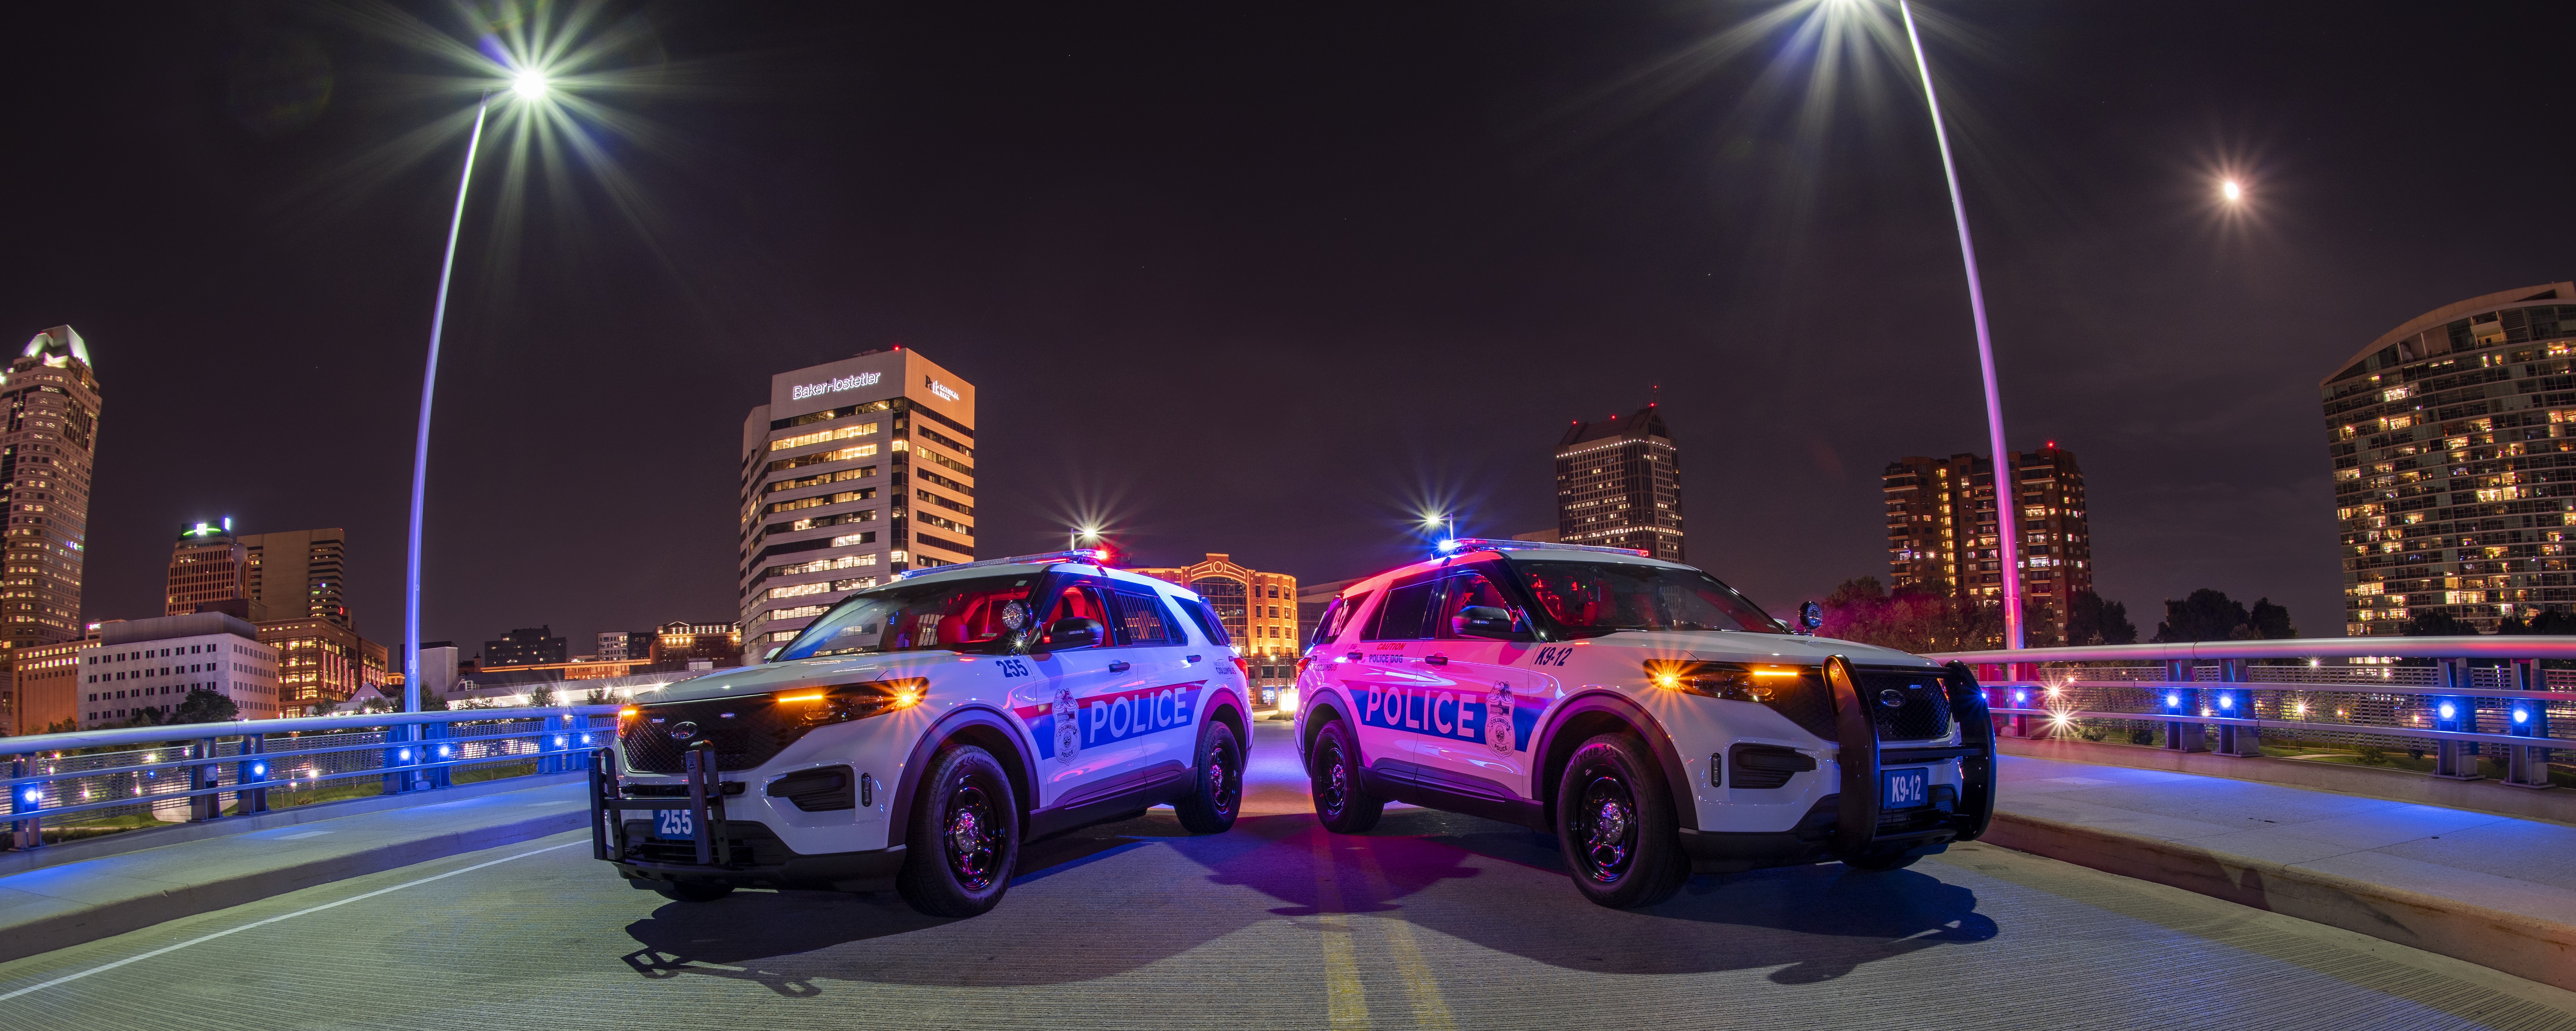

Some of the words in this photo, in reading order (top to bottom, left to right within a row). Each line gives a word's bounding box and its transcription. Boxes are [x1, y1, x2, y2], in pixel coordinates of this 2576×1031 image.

[793, 373, 880, 399] BakerHostetler
[1369, 654, 1389, 662] POLICE
[1390, 654, 1403, 663] DOG
[1534, 647, 1573, 666] K9-12
[996, 659, 1028, 678] 255
[1089, 687, 1187, 743] POLICE
[1366, 685, 1477, 738] POLICE
[1059, 724, 1075, 733] COLUMBUS
[1491, 718, 1509, 727] COLUMBUS
[1062, 749, 1074, 758] POLICE
[1892, 775, 1921, 802] K9-12
[660, 810, 692, 834] 255
